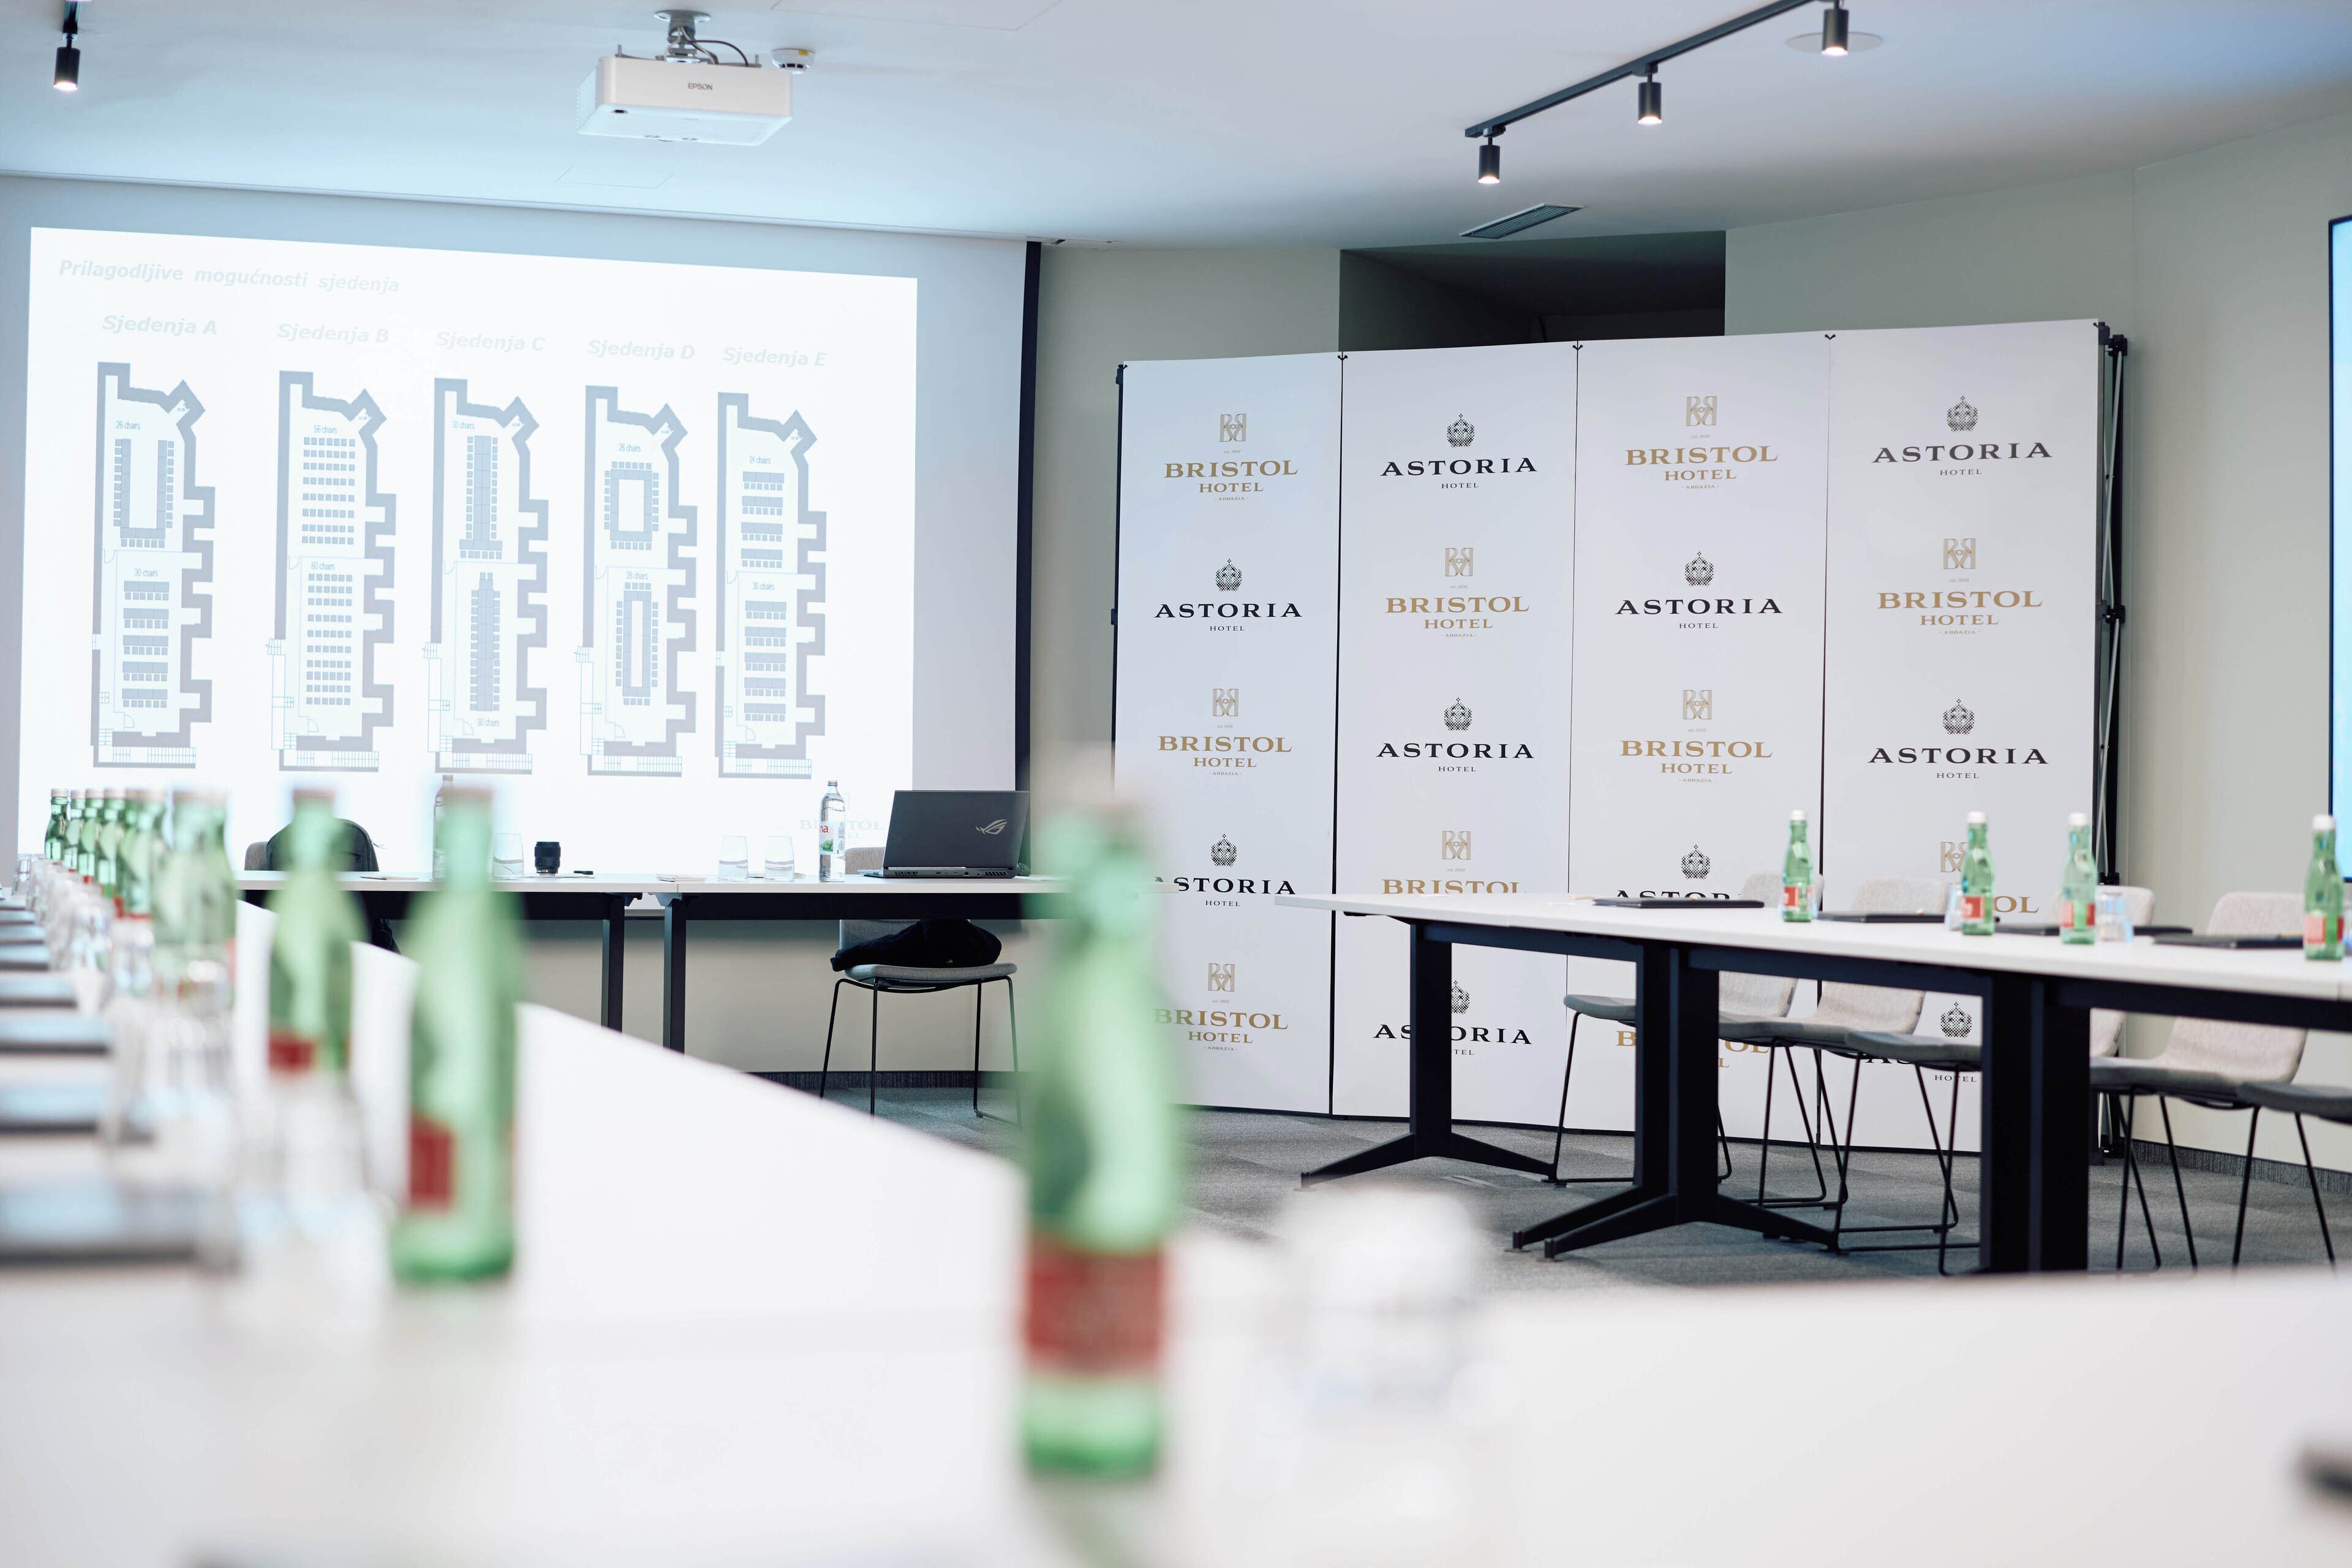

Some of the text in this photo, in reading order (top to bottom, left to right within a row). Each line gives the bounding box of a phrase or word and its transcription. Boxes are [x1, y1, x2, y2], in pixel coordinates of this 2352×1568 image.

[59, 259, 400, 293] Prilagodljive mogućnosti sjedenja
[102, 314, 217, 336] Sjedenja A
[277, 323, 390, 344] Sjedenja B
[435, 331, 546, 352] Sjedenja C
[587, 339, 695, 360] Sjedenja D
[722, 347, 827, 368] Sjedenja E
[1625, 445, 1777, 466] BRISTOL
[1871, 442, 2052, 463] ASTORIA
[1164, 460, 1298, 478] BRISTOL
[1379, 457, 1538, 477] ASTORIA
[1665, 469, 1736, 481] HOTEL
[1199, 482, 1264, 493] HOTEL
[1385, 596, 1529, 613] BRISTOL
[1614, 598, 1783, 615] ASTORIA
[1878, 590, 2043, 609] BRISTOL
[1153, 603, 1303, 618] ASTORIA
[1920, 614, 1999, 625] HOTEL
[1424, 619, 1493, 629] HOTEL
[1158, 736, 1292, 753] BRISTOL
[1376, 742, 1534, 759] ASTORIA
[1620, 740, 1773, 758] BRISTOL
[1194, 757, 1257, 768] HOTEL
[1867, 747, 2049, 764] ASTORIA
[1660, 763, 1732, 774] HOTEL
[1155, 1009, 1289, 1030] BRISTOL
[1188, 1031, 1253, 1044] HOTEL
[1372, 1024, 1533, 1045] ASORIA
